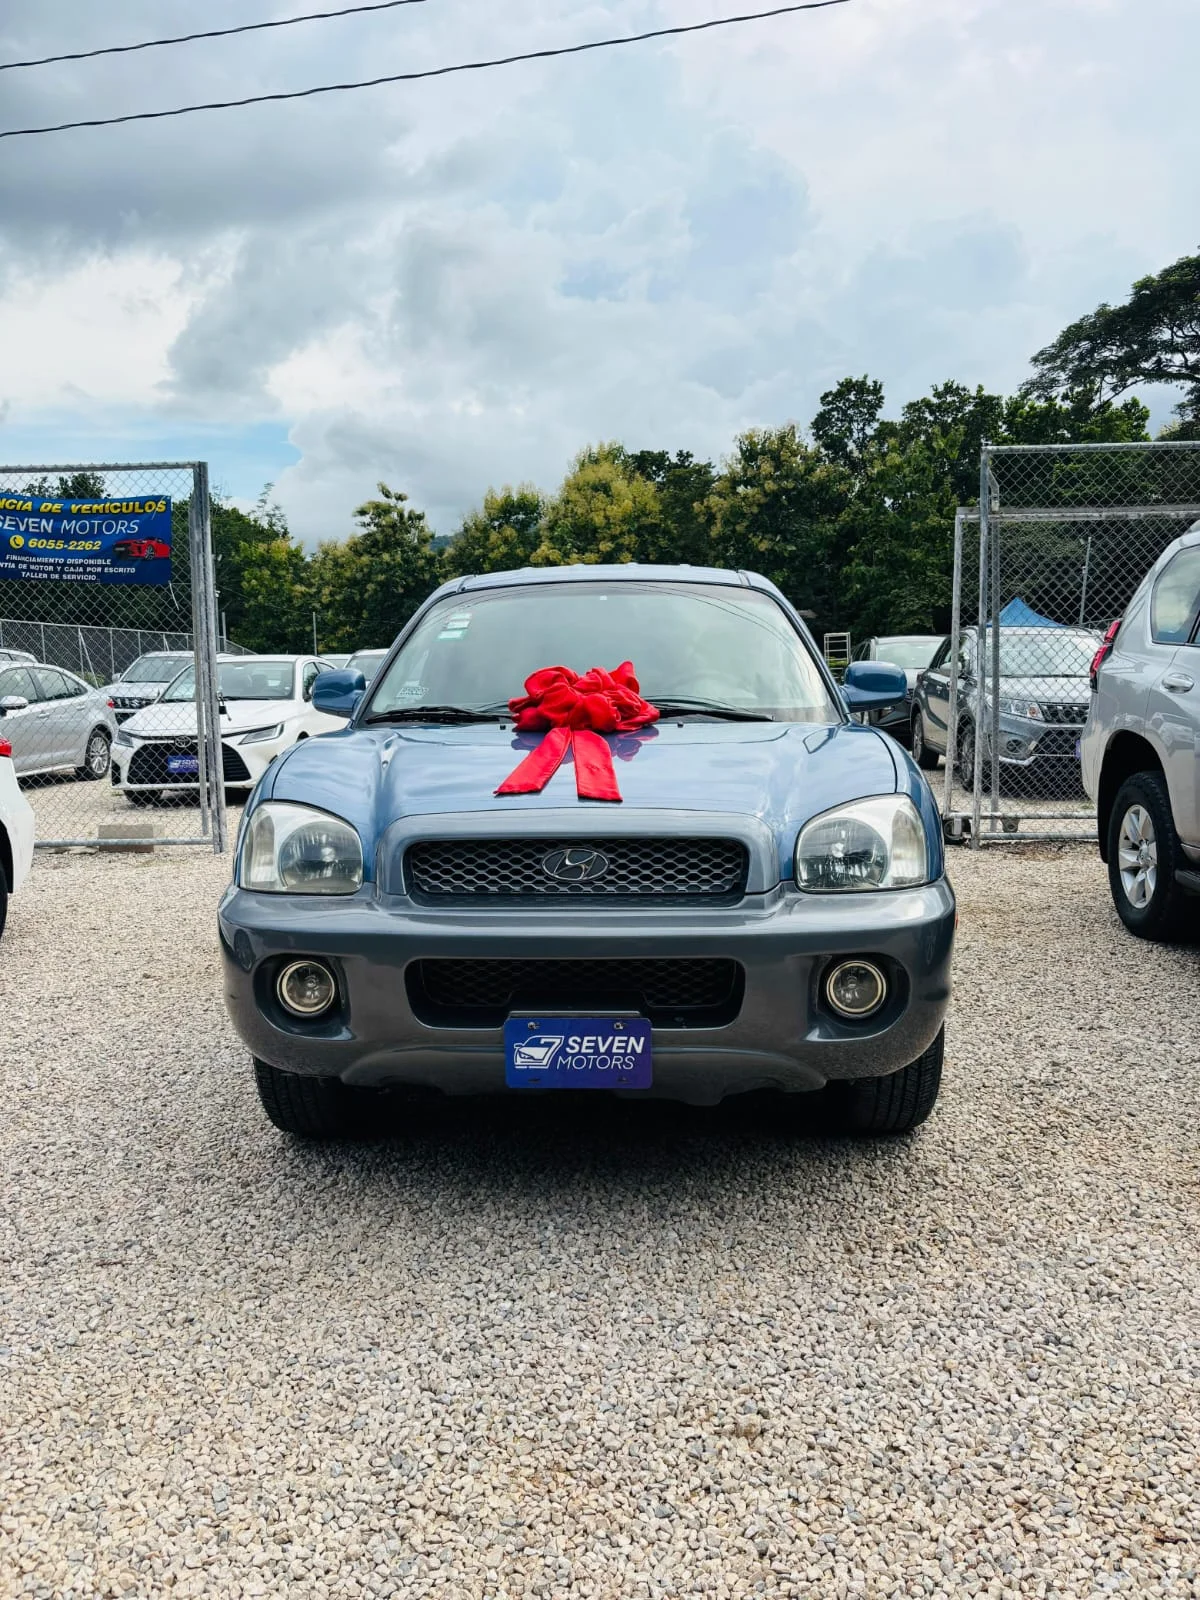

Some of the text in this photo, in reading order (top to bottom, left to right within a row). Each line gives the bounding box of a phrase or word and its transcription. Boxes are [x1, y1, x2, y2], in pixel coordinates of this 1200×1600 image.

[39, 502, 64, 512] DE
[61, 519, 140, 535] MOTORS
[28, 538, 102, 551] 6055-2262
[6, 554, 64, 564] FINANCIAMIENTO
[565, 1036, 645, 1054] SEVEN
[556, 1055, 636, 1070] MOTORS
